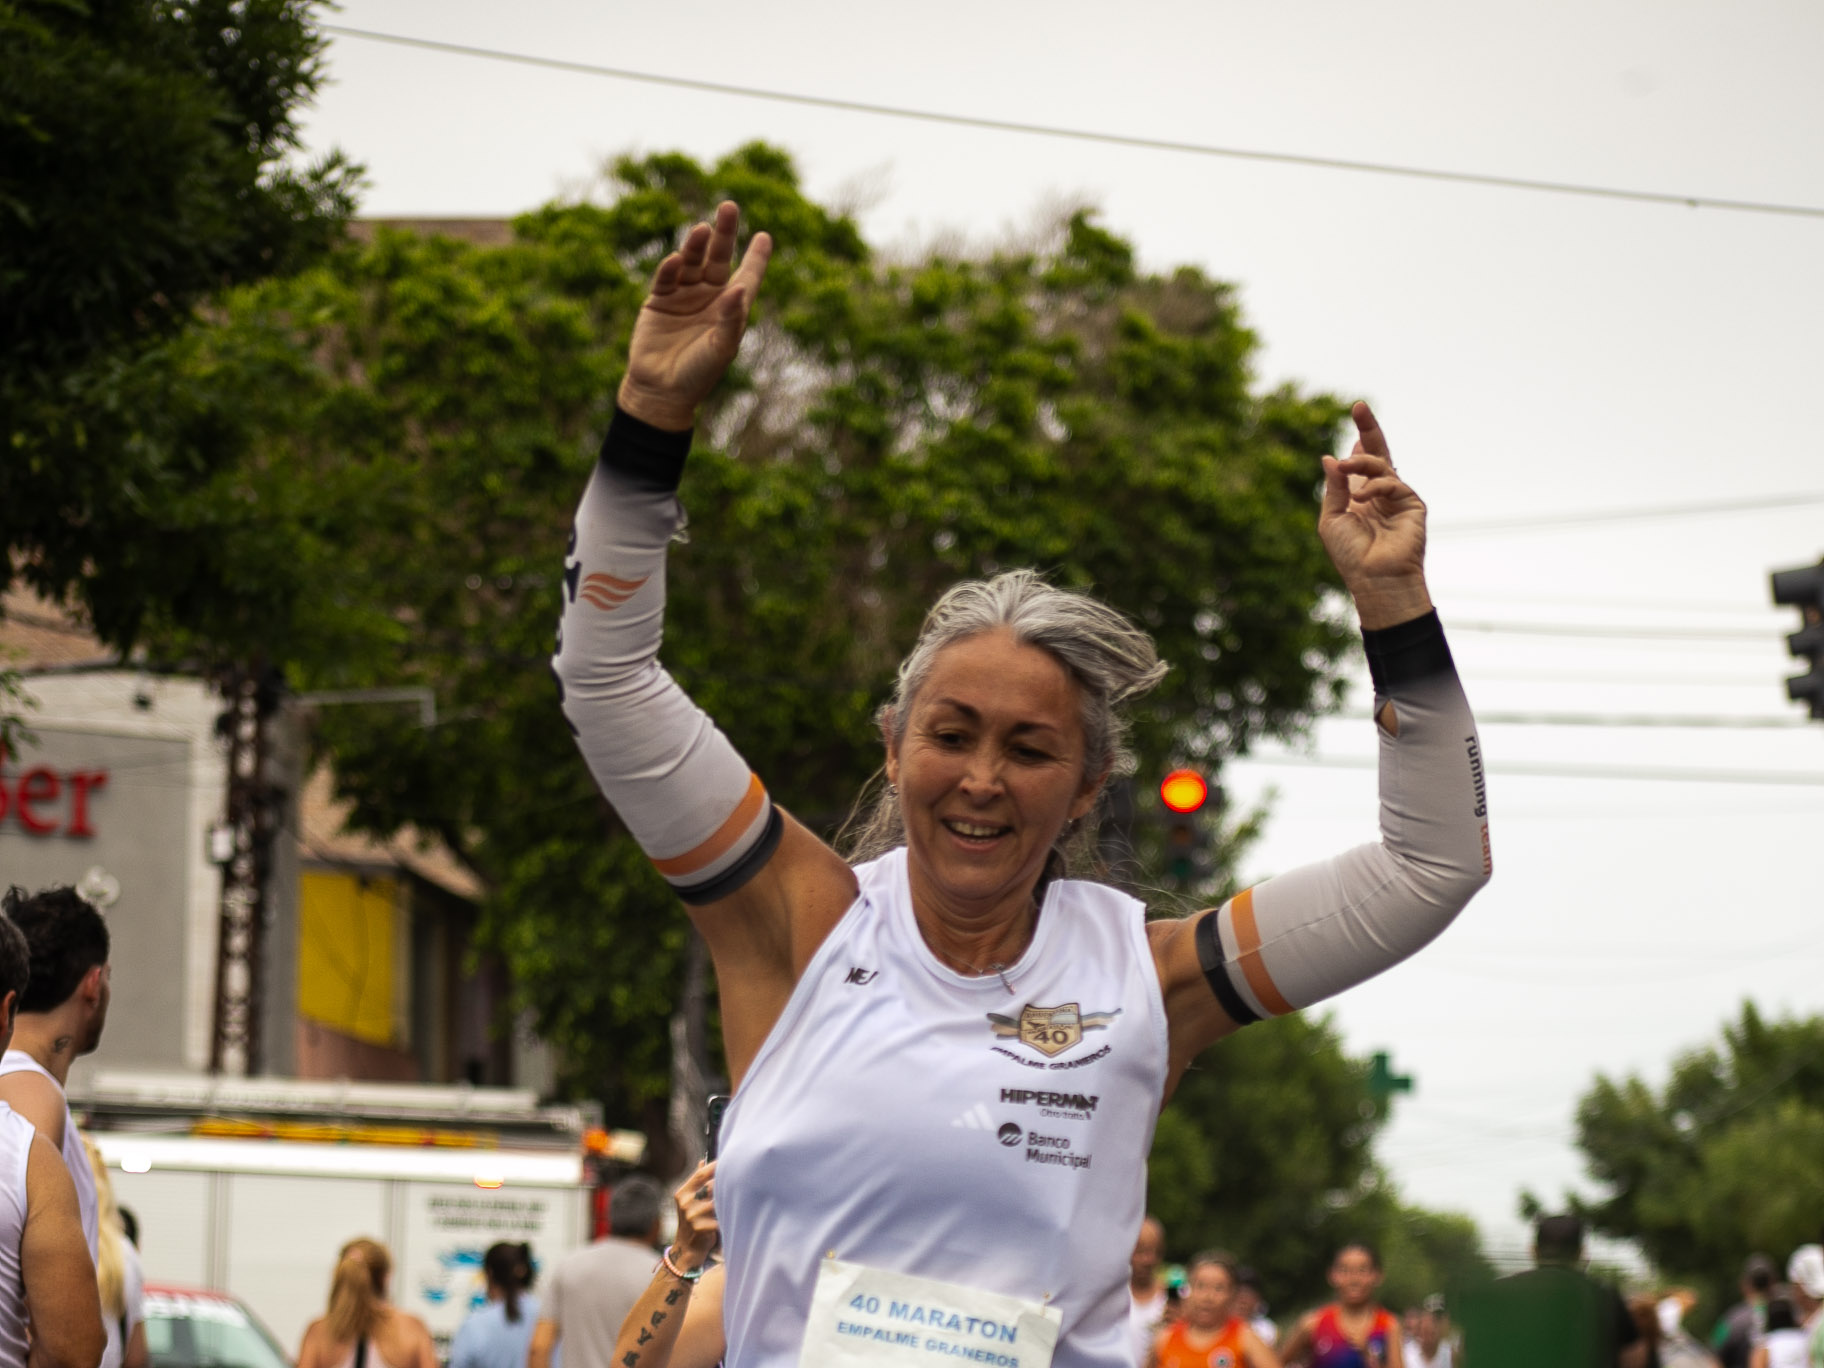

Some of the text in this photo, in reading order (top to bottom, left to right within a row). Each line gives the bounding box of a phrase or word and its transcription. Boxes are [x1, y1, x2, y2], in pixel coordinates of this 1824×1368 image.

[1465, 735, 1487, 818] running
[0, 765, 108, 837] er
[1033, 1030, 1068, 1045] 40
[1028, 1131, 1070, 1149] Banco
[1026, 1148, 1092, 1170] Municipal
[850, 1294, 1018, 1344] 40 MARATON
[837, 1321, 919, 1348] EMPALME
